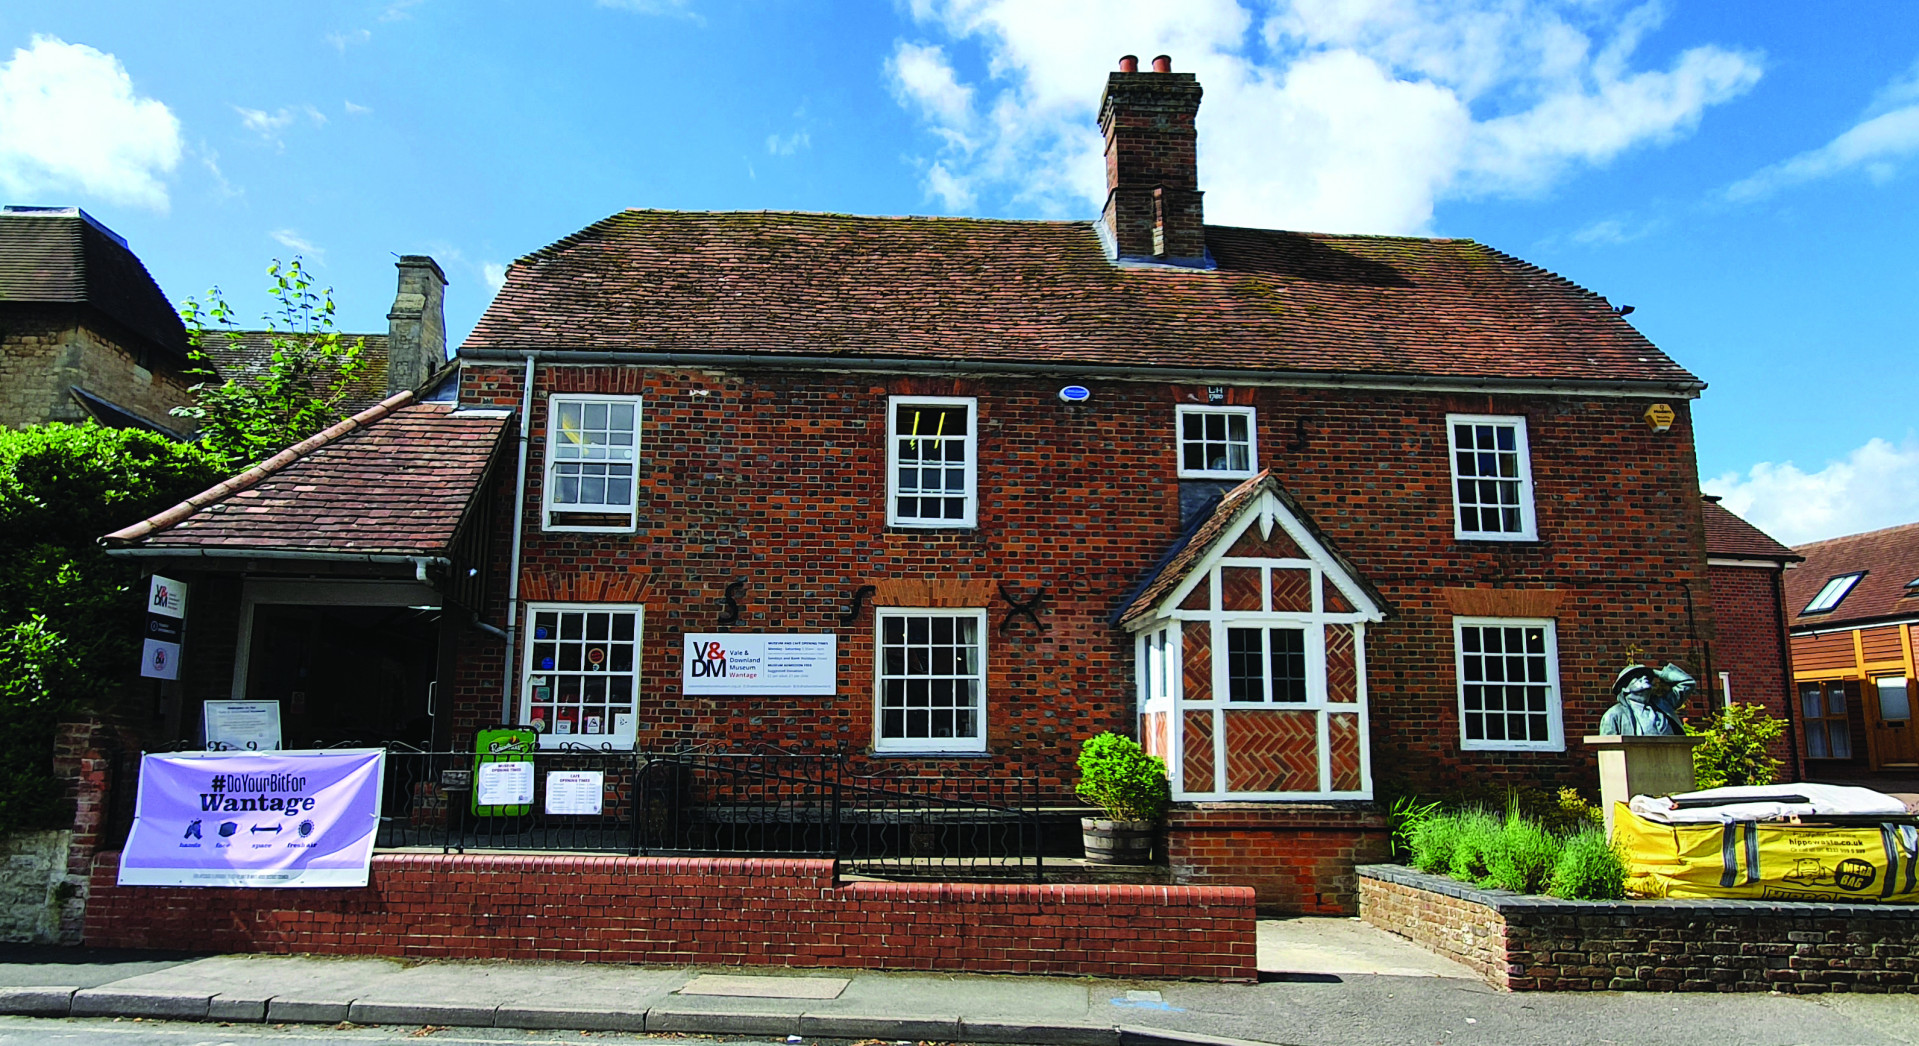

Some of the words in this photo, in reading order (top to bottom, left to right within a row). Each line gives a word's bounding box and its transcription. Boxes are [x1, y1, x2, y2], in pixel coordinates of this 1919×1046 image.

[693, 641, 726, 660] V&
[691, 659, 727, 678] DM
[211, 773, 306, 792] #DoYourBitFor
[200, 793, 316, 816] Wantage
[1842, 862, 1873, 877] MEGA
[1840, 874, 1864, 888] BAG
